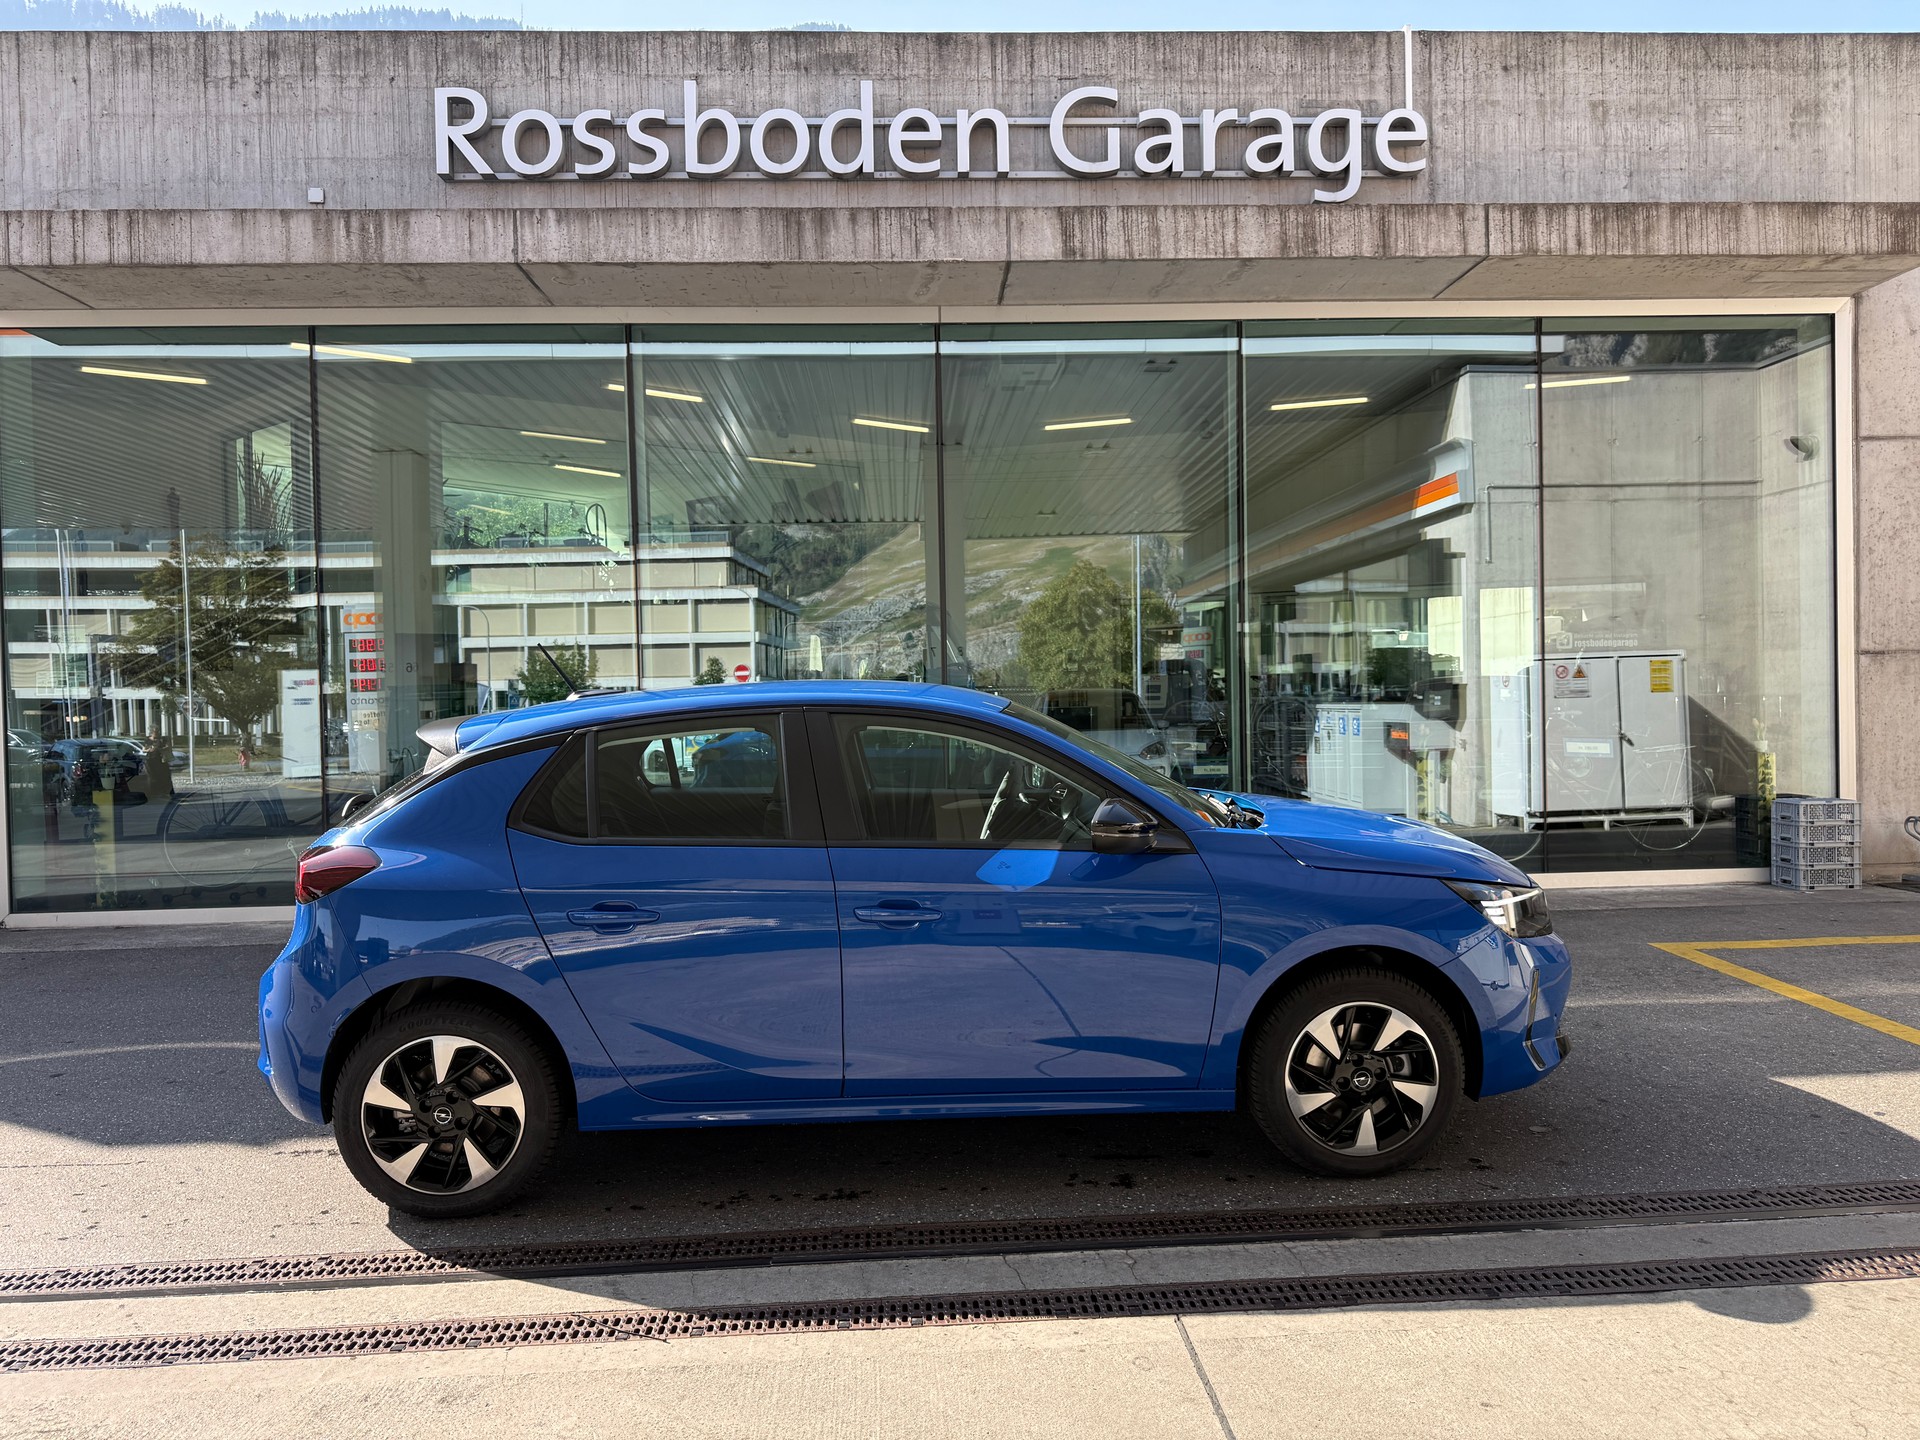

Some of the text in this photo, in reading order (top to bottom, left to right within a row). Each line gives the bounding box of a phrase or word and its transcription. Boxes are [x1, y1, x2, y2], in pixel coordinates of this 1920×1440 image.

[434, 80, 1428, 203] Rossboden Garage
[1574, 638, 1638, 648] rossbodengarage
